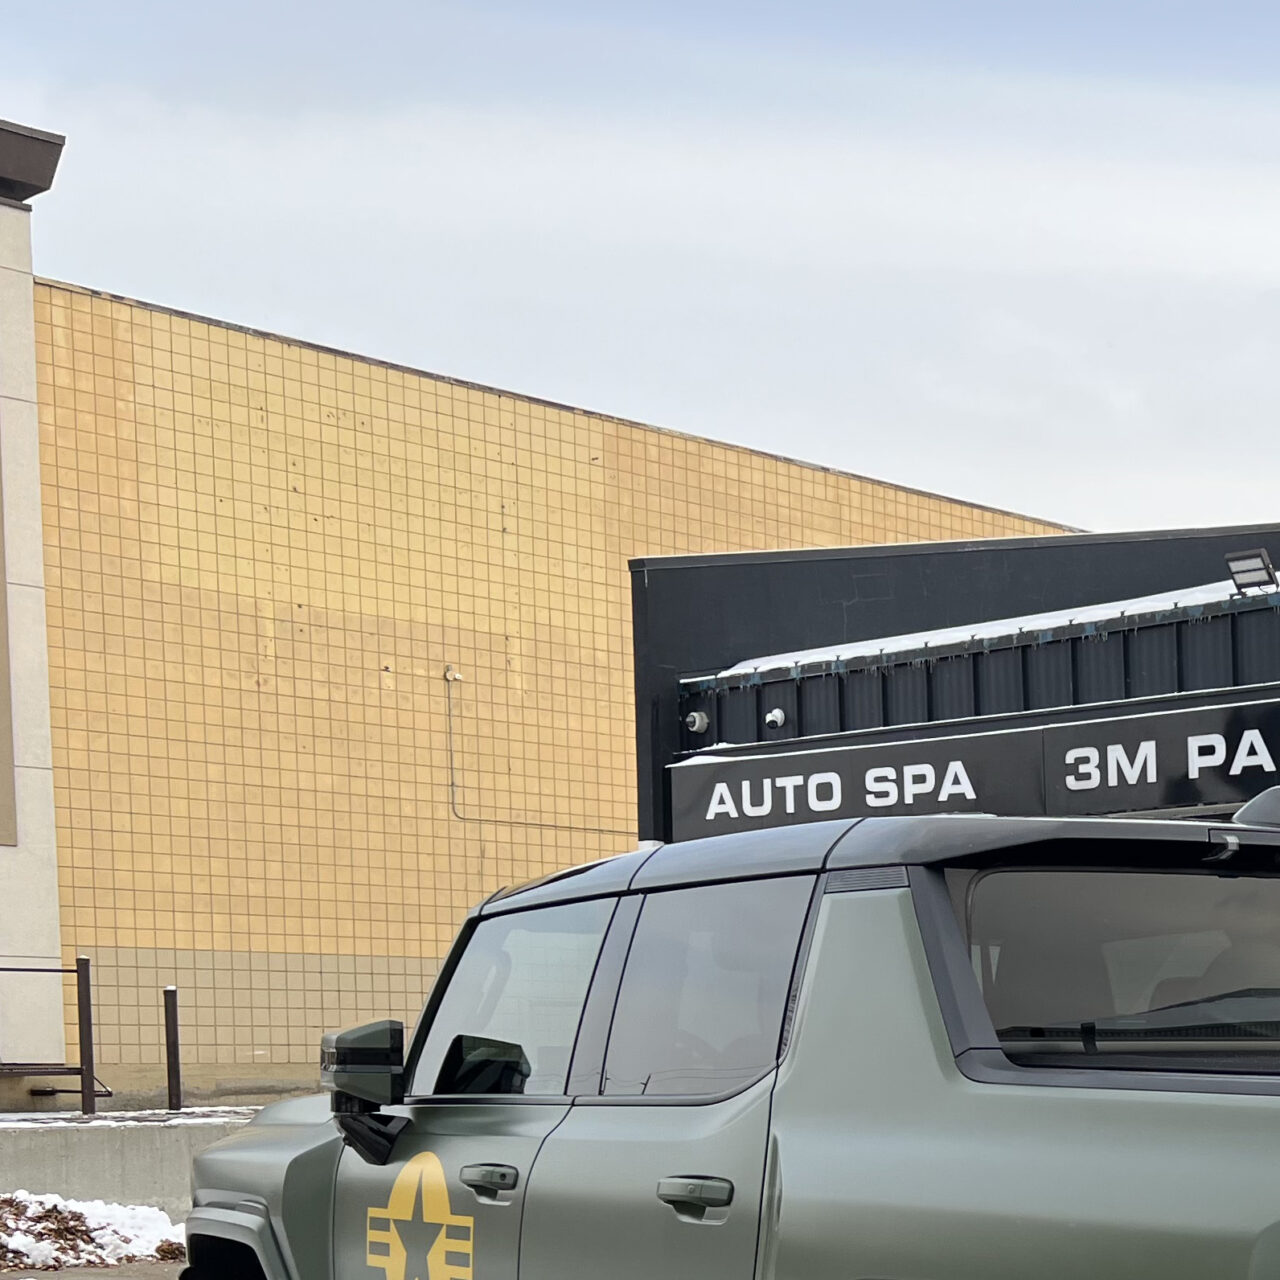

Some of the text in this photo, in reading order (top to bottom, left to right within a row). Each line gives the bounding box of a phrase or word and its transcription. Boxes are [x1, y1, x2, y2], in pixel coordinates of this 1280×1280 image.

[705, 760, 977, 820] AUTO SPA
[1064, 740, 1157, 791] 3M
